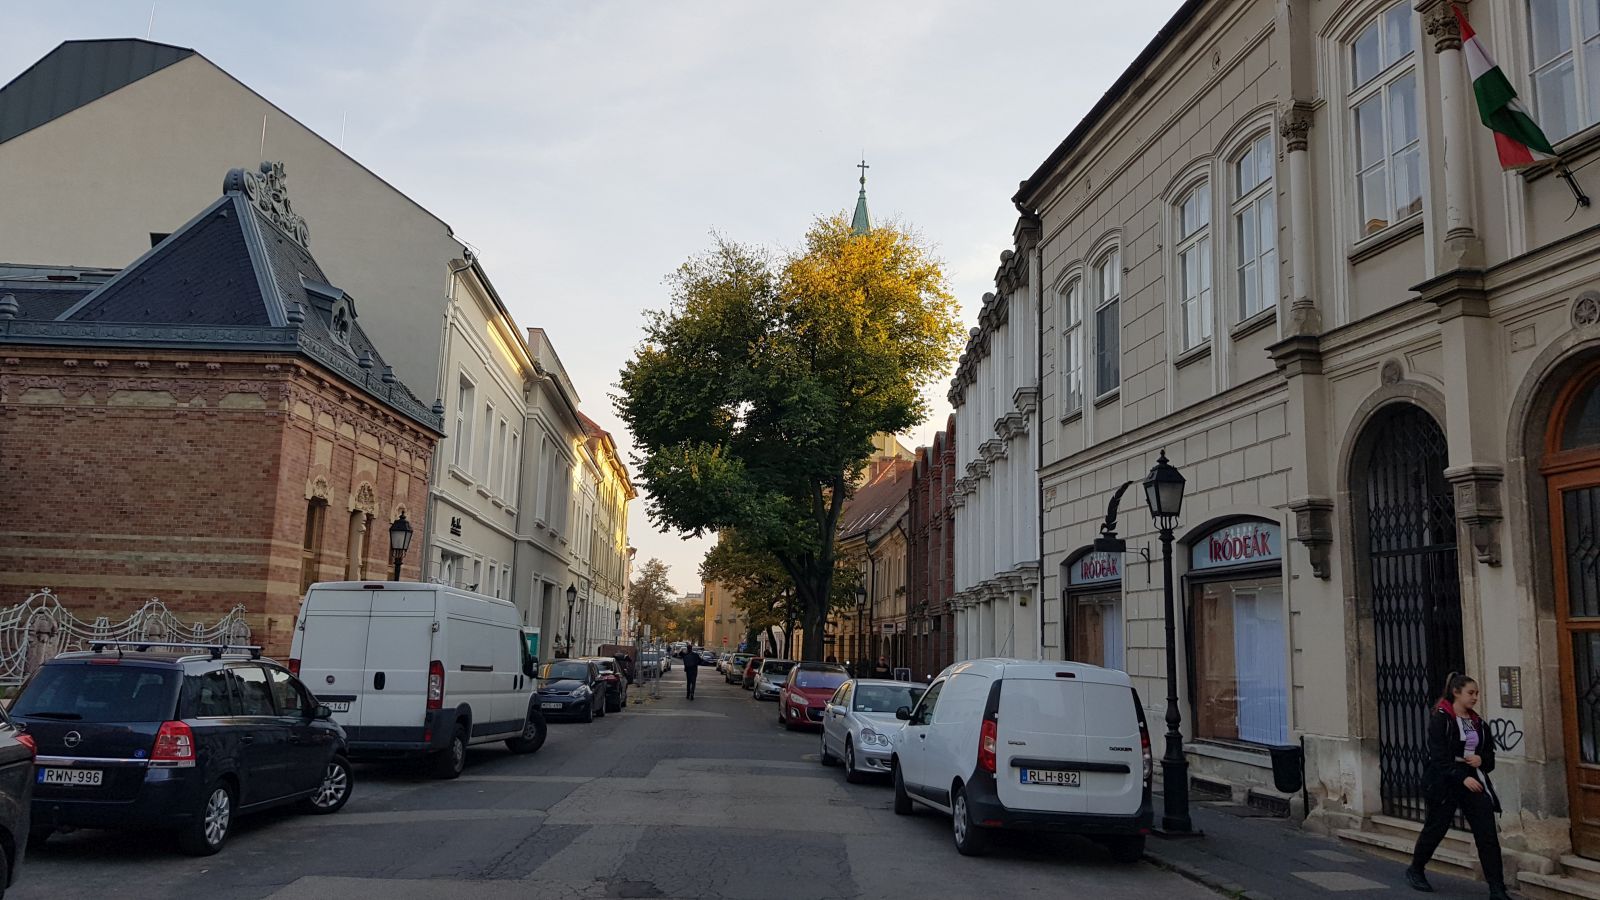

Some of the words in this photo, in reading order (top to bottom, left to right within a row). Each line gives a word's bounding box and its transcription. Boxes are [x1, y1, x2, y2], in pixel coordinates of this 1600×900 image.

[1209, 527, 1271, 562] ÍRÓDEÁK
[1081, 554, 1118, 580] ÍRÓDEÁK
[46, 770, 100, 784] RWN-996
[1029, 770, 1077, 784] RLH-892
